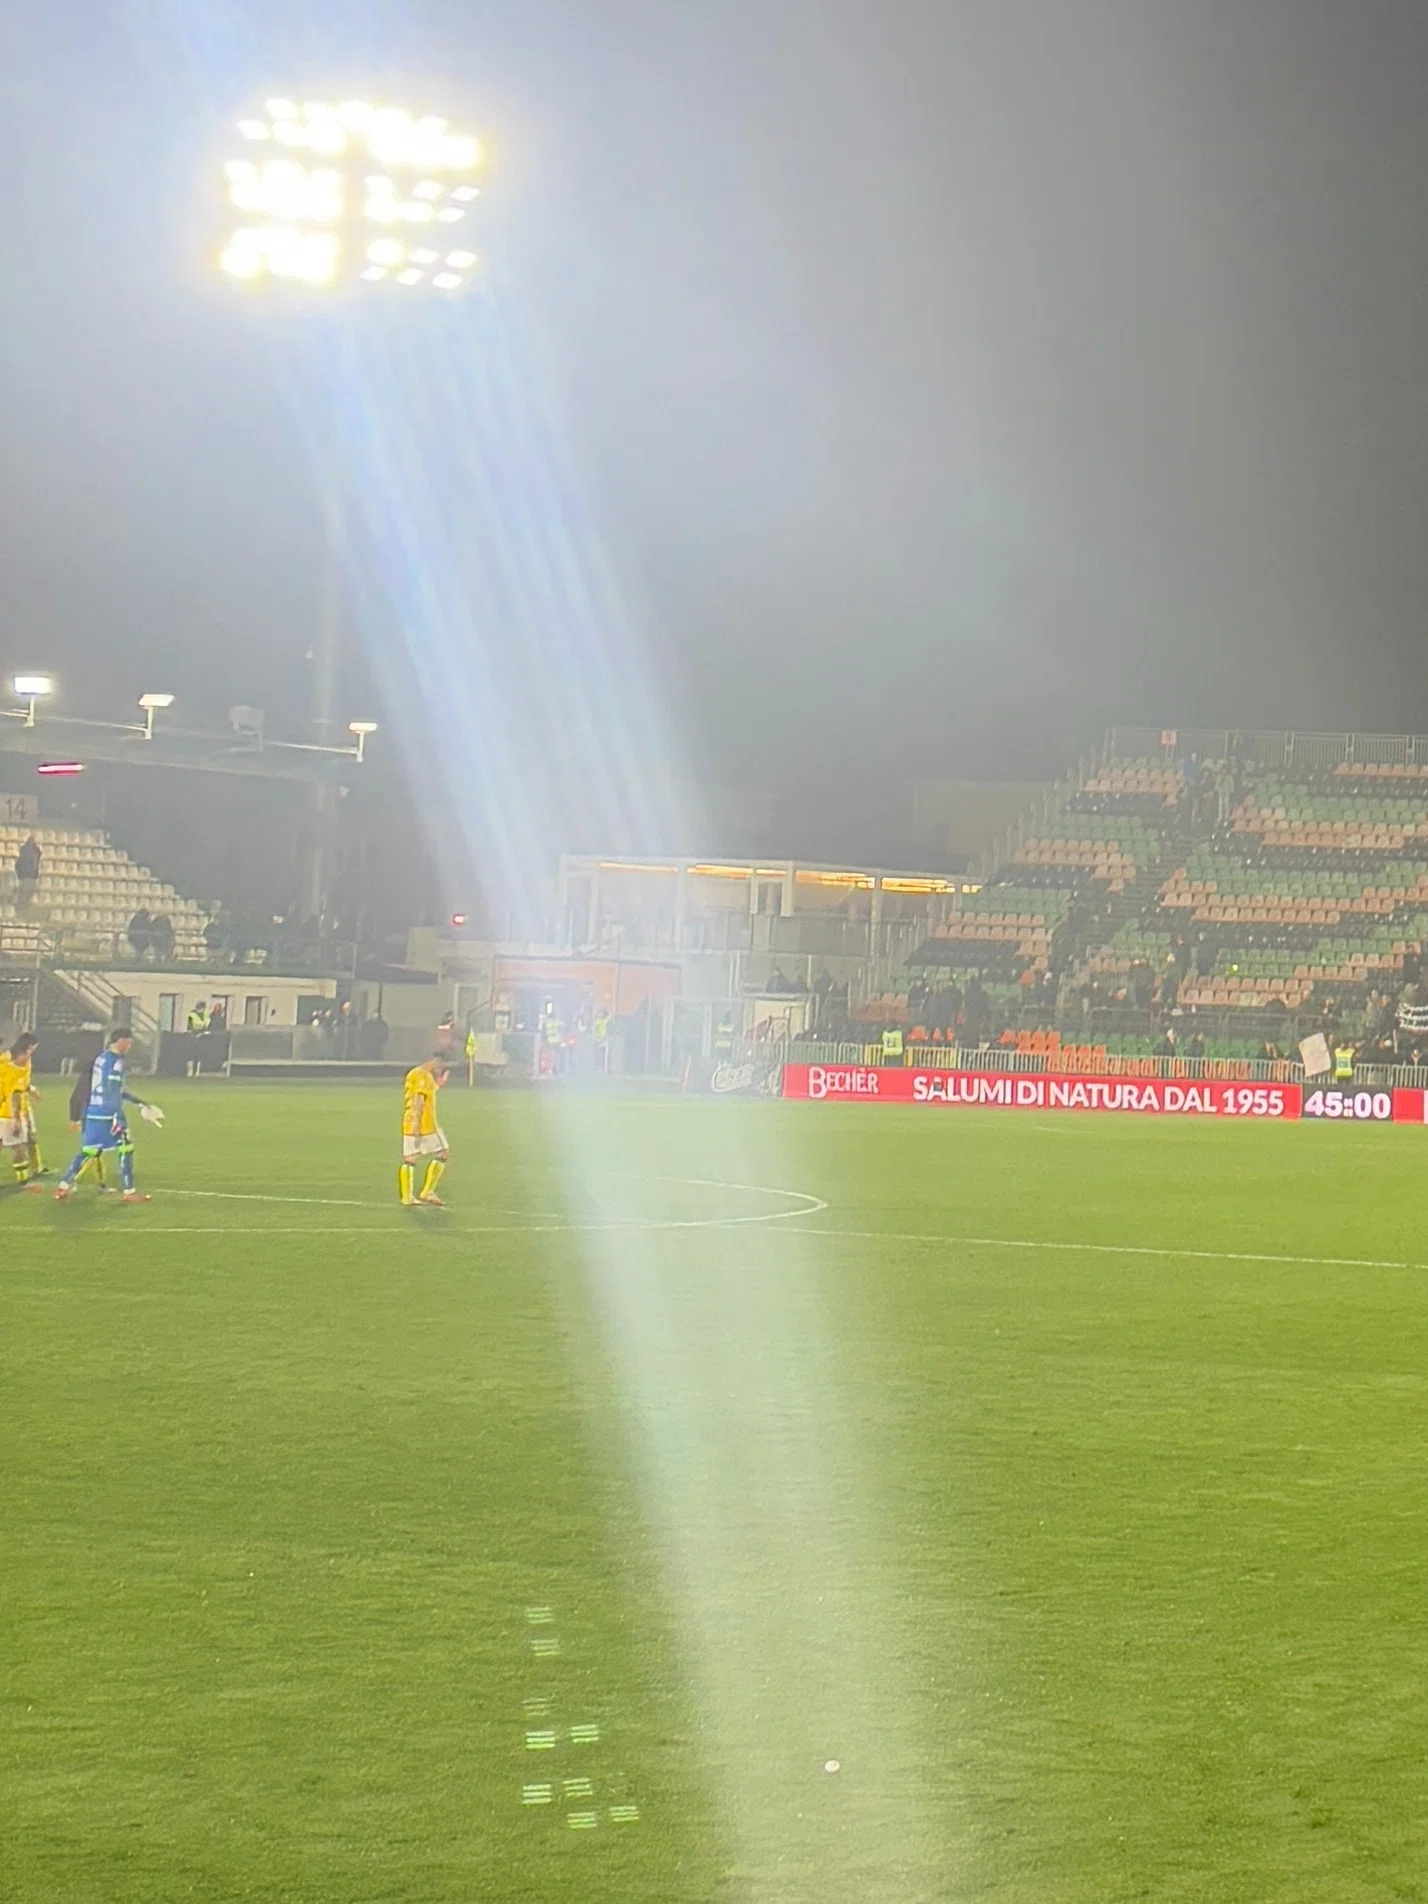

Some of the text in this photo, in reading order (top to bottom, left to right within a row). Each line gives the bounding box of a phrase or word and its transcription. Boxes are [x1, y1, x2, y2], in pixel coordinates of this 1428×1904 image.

[913, 1075, 1285, 1116] SALUMI DI NATURA DAL 1955
[1304, 1091, 1391, 1119] 45:00
